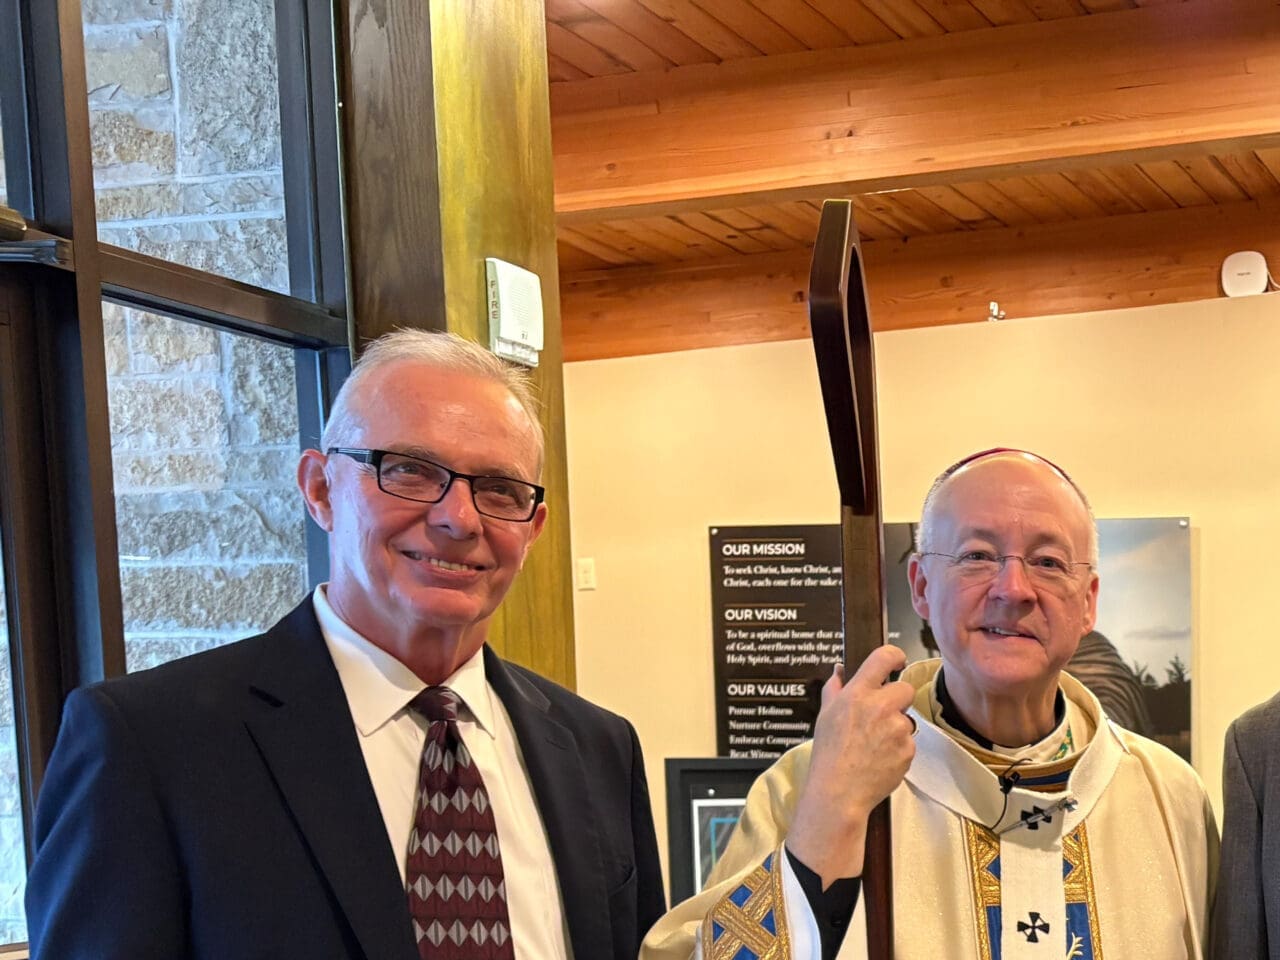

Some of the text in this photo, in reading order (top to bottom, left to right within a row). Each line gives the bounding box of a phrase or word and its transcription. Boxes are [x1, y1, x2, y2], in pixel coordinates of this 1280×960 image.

[490, 280, 499, 319] FIRE
[722, 543, 805, 556] OUR MISSION
[723, 565, 735, 575] To
[754, 565, 780, 575] Christ,
[803, 564, 831, 575] Christ,
[723, 578, 751, 588] Christ,
[752, 577, 771, 587] each
[773, 579, 789, 587] one
[790, 577, 802, 587] for
[804, 577, 817, 587] the
[819, 577, 839, 586] sake
[724, 608, 797, 621] OUR VISION
[726, 630, 737, 639] To
[738, 630, 749, 639] be
[757, 630, 790, 642] spiritual
[791, 630, 815, 639] home
[816, 630, 833, 639] that
[726, 642, 736, 651] of
[736, 642, 757, 652] God,
[758, 642, 796, 651] overflows
[797, 642, 815, 651] with
[816, 642, 830, 650] the
[726, 655, 746, 666] Holy
[747, 655, 772, 666] Spirit,
[774, 655, 790, 664] and
[790, 655, 821, 666] joyfully
[727, 684, 806, 696] OUR VALUES
[728, 706, 793, 716] Pursue Holiness
[728, 721, 811, 732] Nurture Community
[729, 735, 764, 745] Embrace
[729, 750, 749, 758] Bear
